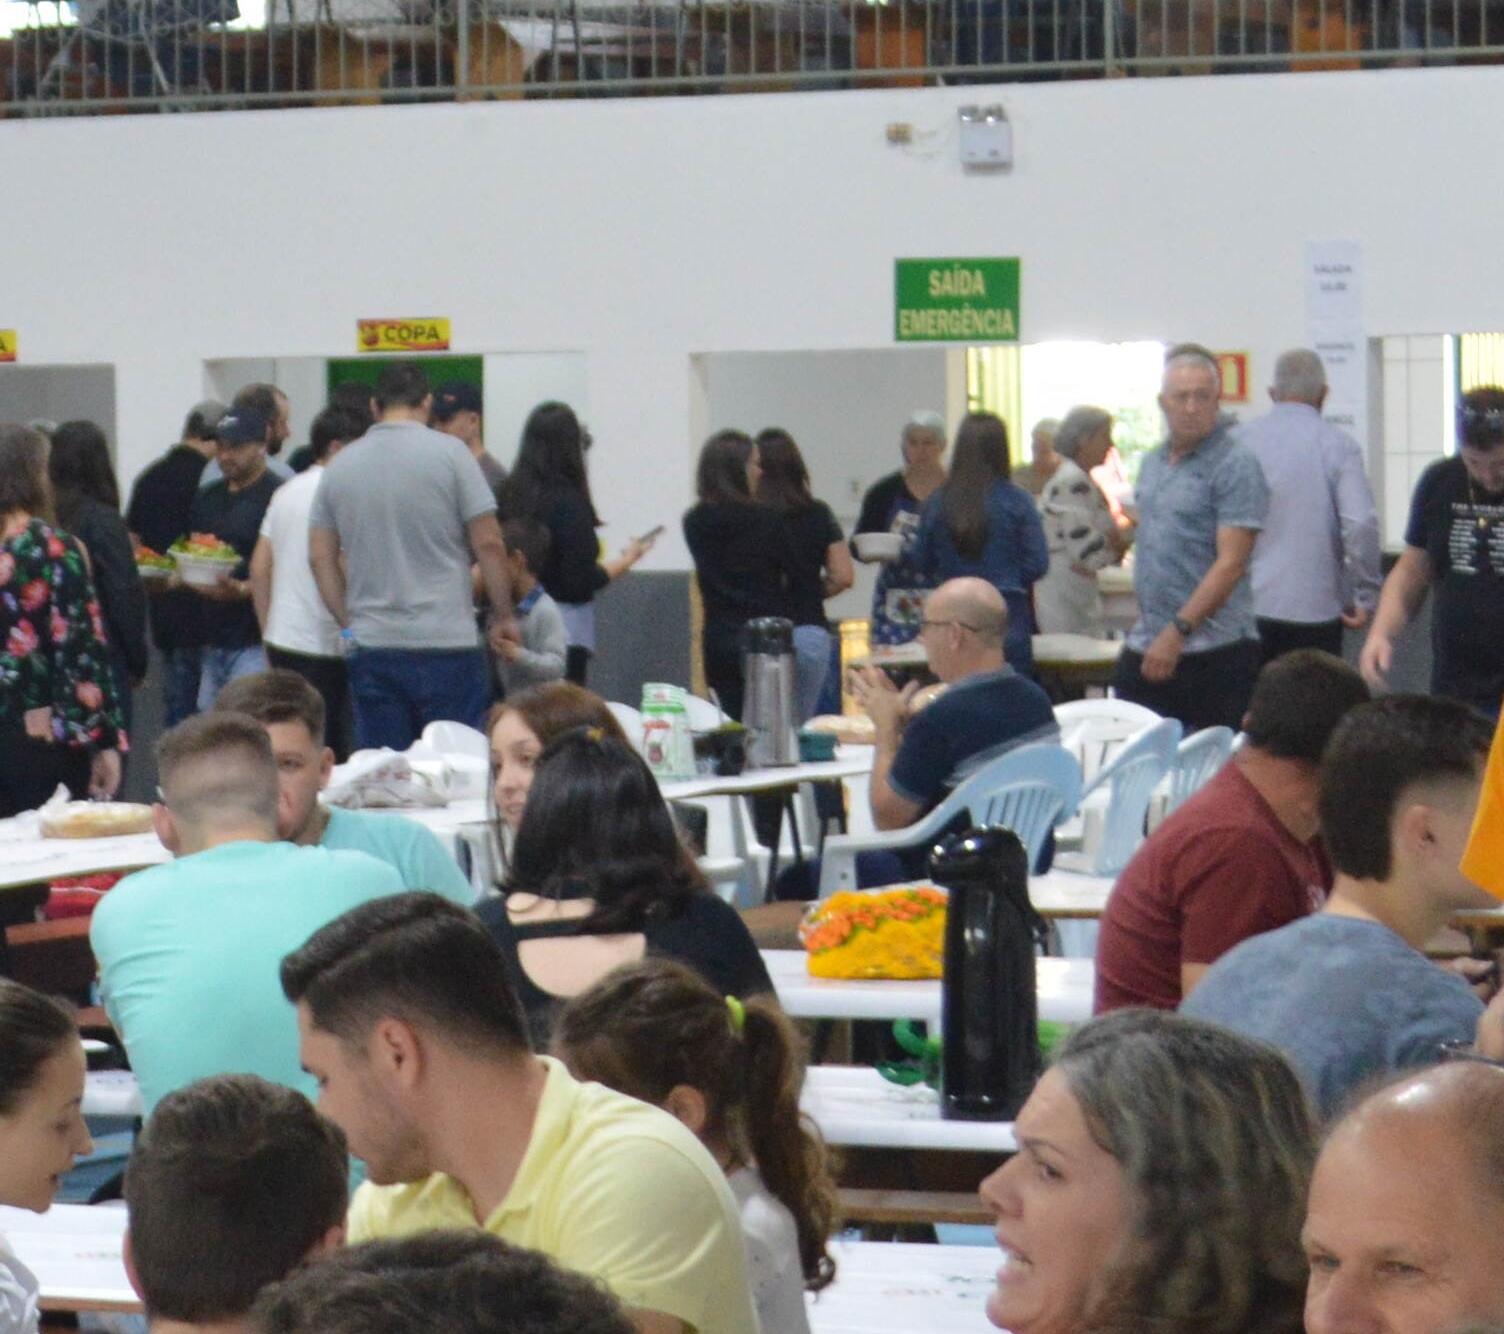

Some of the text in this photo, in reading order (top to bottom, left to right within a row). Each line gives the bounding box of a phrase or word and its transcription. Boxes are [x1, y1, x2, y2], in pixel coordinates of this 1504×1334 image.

[928, 263, 986, 298] SAÍDA
[383, 325, 441, 342] COPA
[899, 302, 1016, 336] EMERGÊNCIA
